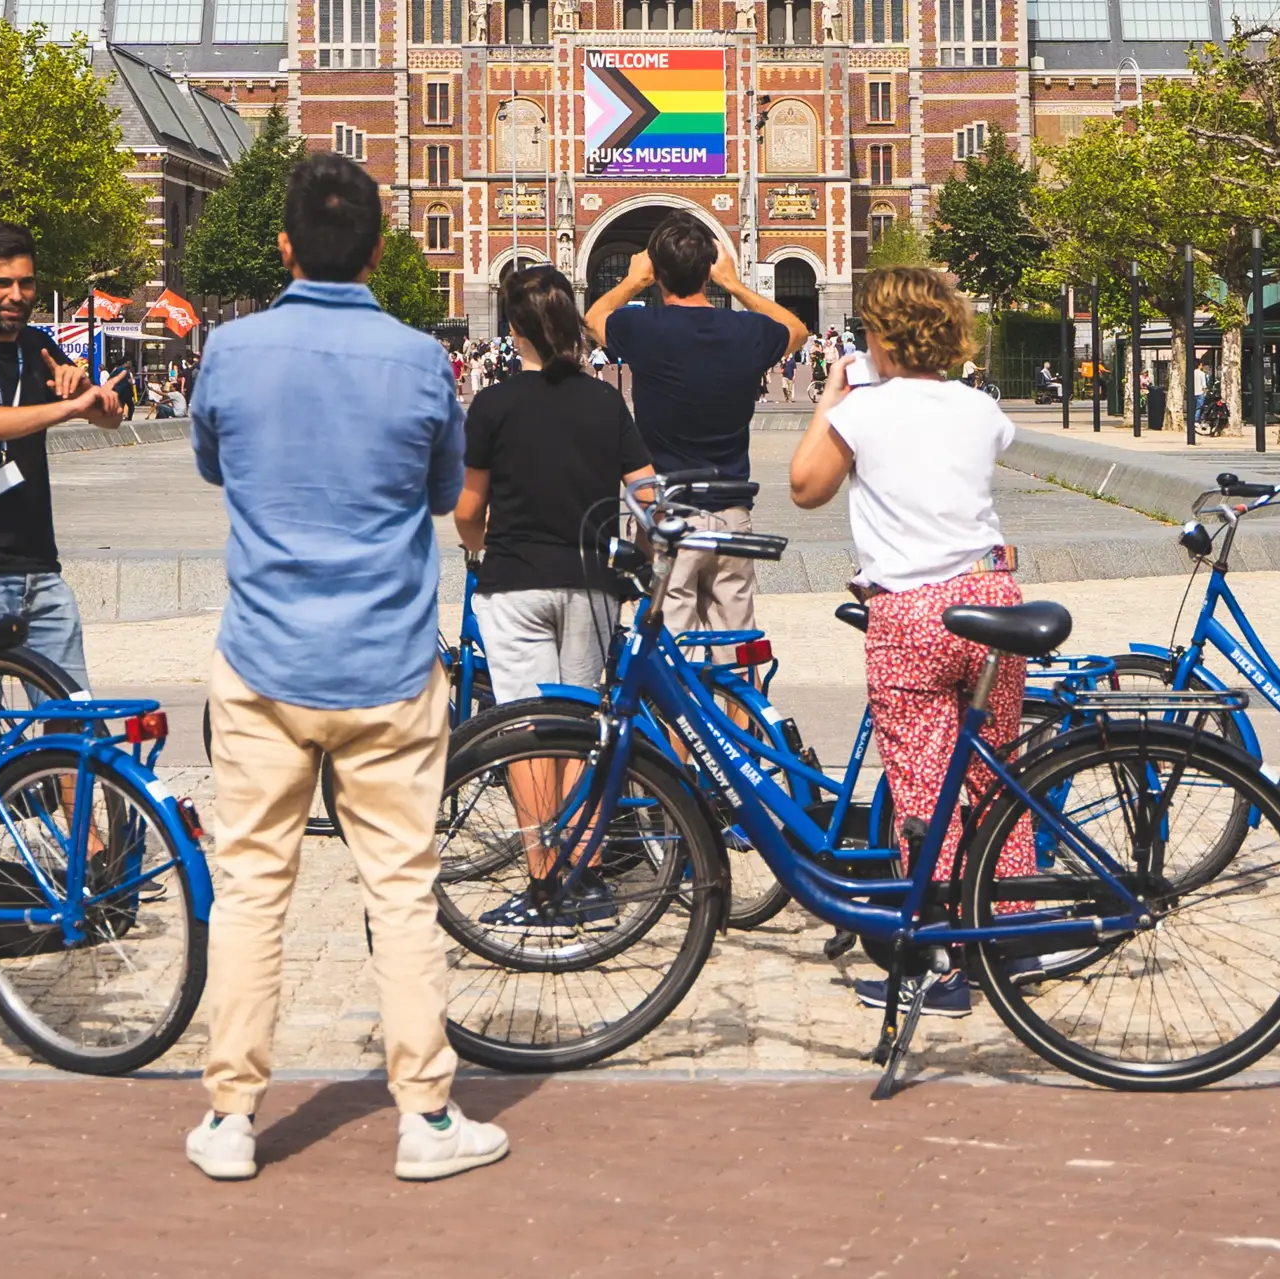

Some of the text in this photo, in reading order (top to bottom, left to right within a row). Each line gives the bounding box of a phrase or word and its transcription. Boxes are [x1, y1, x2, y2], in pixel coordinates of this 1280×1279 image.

[588, 52, 669, 68] WELCOME
[589, 147, 707, 163] RIJKS MUSEUM
[1230, 648, 1257, 674] BIKE
[1251, 671, 1266, 684] IS
[676, 714, 700, 742] BIKE
[693, 740, 707, 754] IS
[701, 752, 730, 787] READY
